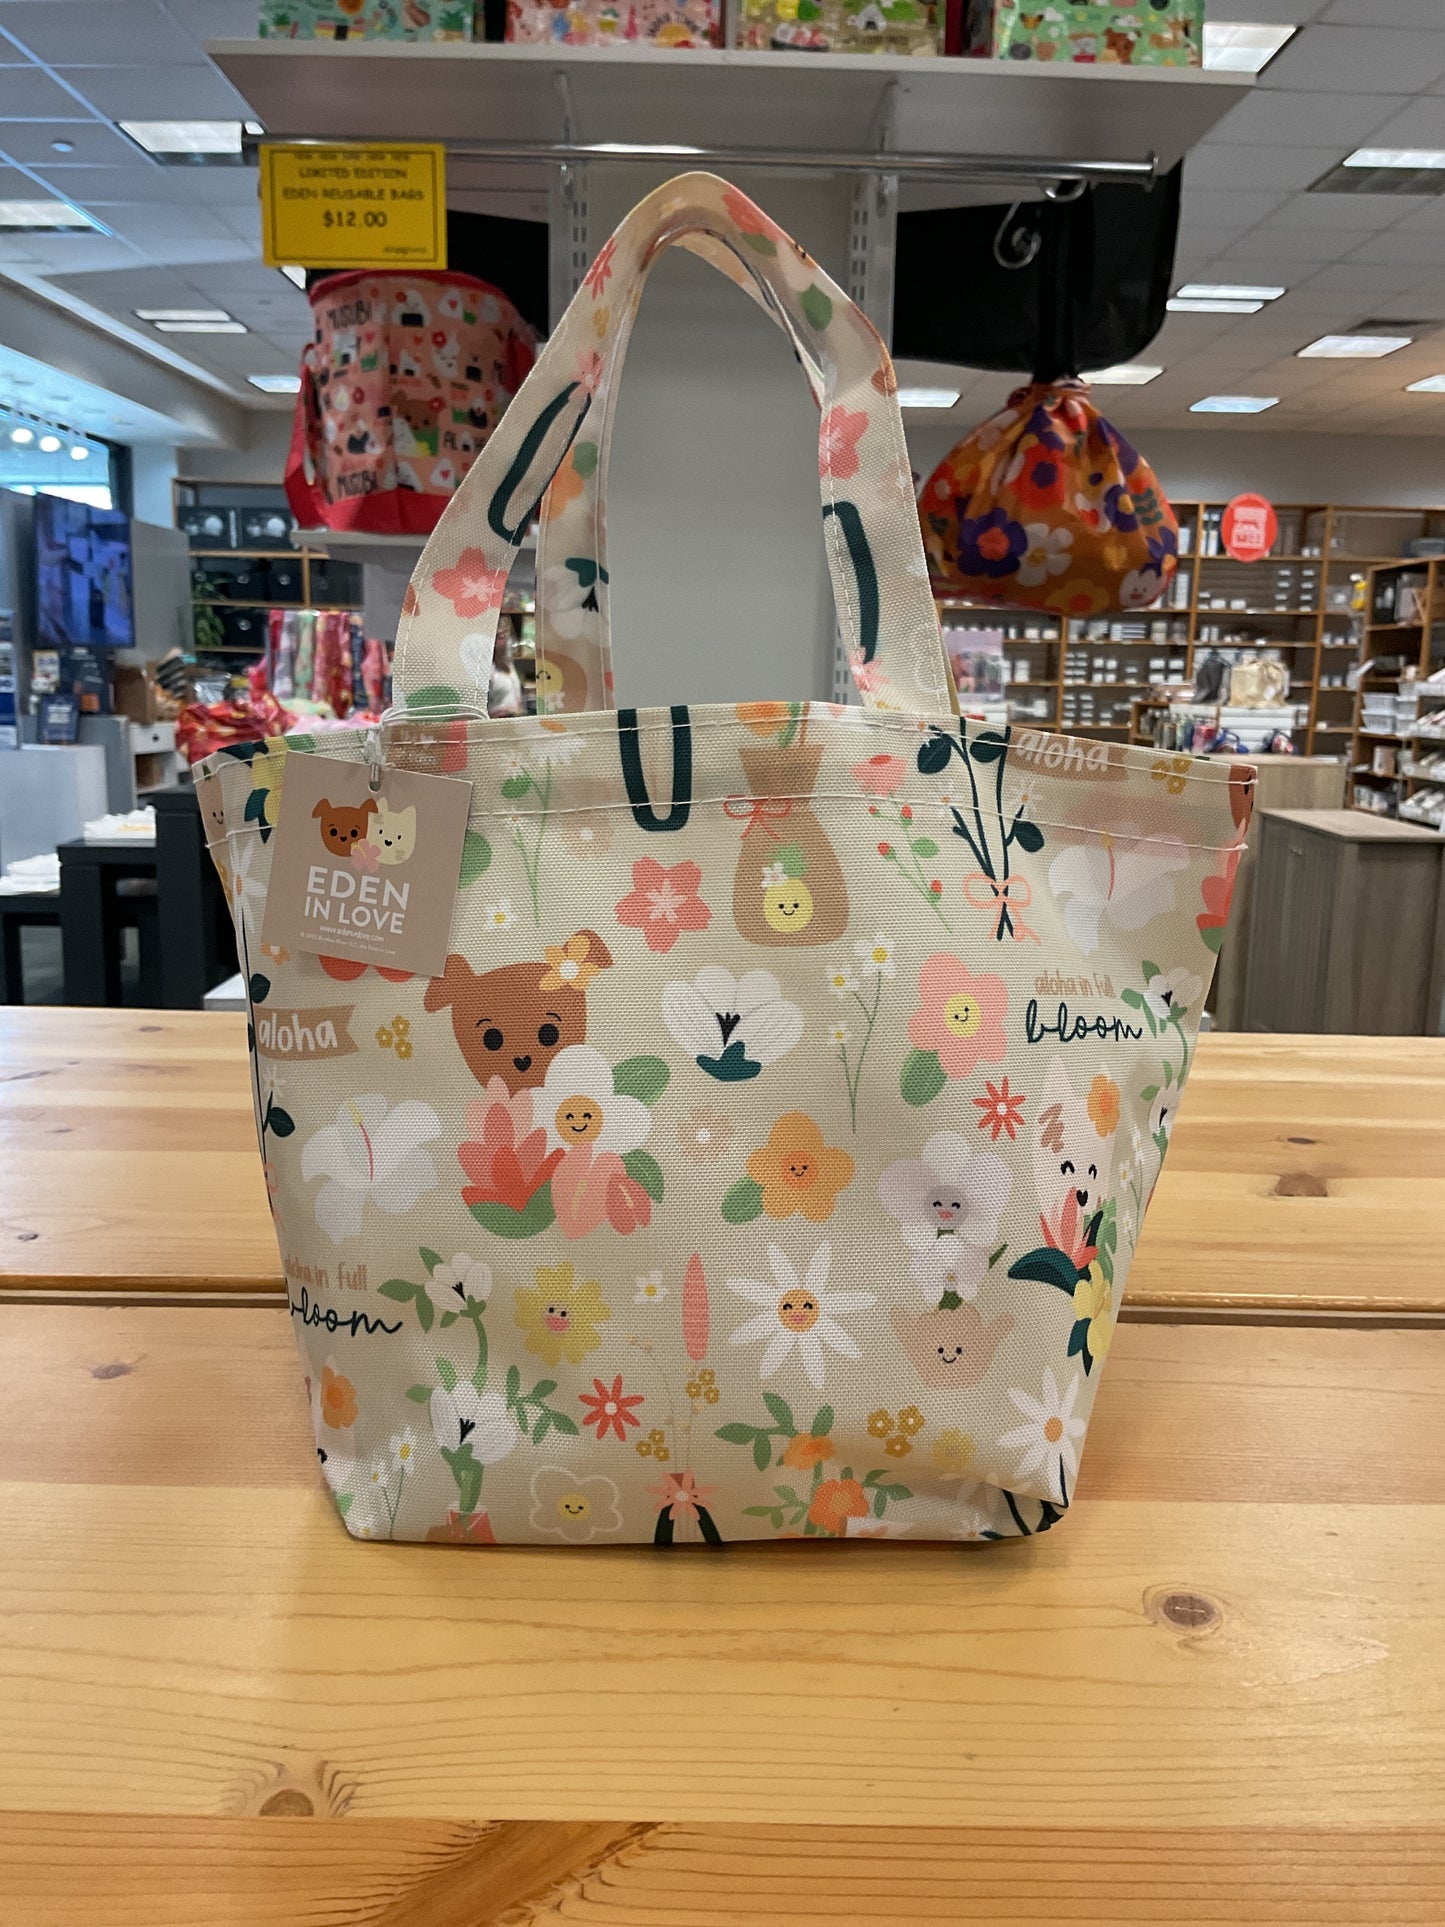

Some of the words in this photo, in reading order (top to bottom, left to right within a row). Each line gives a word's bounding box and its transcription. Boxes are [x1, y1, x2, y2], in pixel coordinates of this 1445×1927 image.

[323, 210, 389, 228] $12.00
[1015, 731, 1109, 772] aloha
[307, 865, 411, 911] EDEN
[304, 896, 332, 921] IN
[338, 902, 405, 935] LOVE
[259, 1012, 338, 1052] aloha
[1025, 999, 1143, 1043] bloom
[336, 1262, 368, 1291] full
